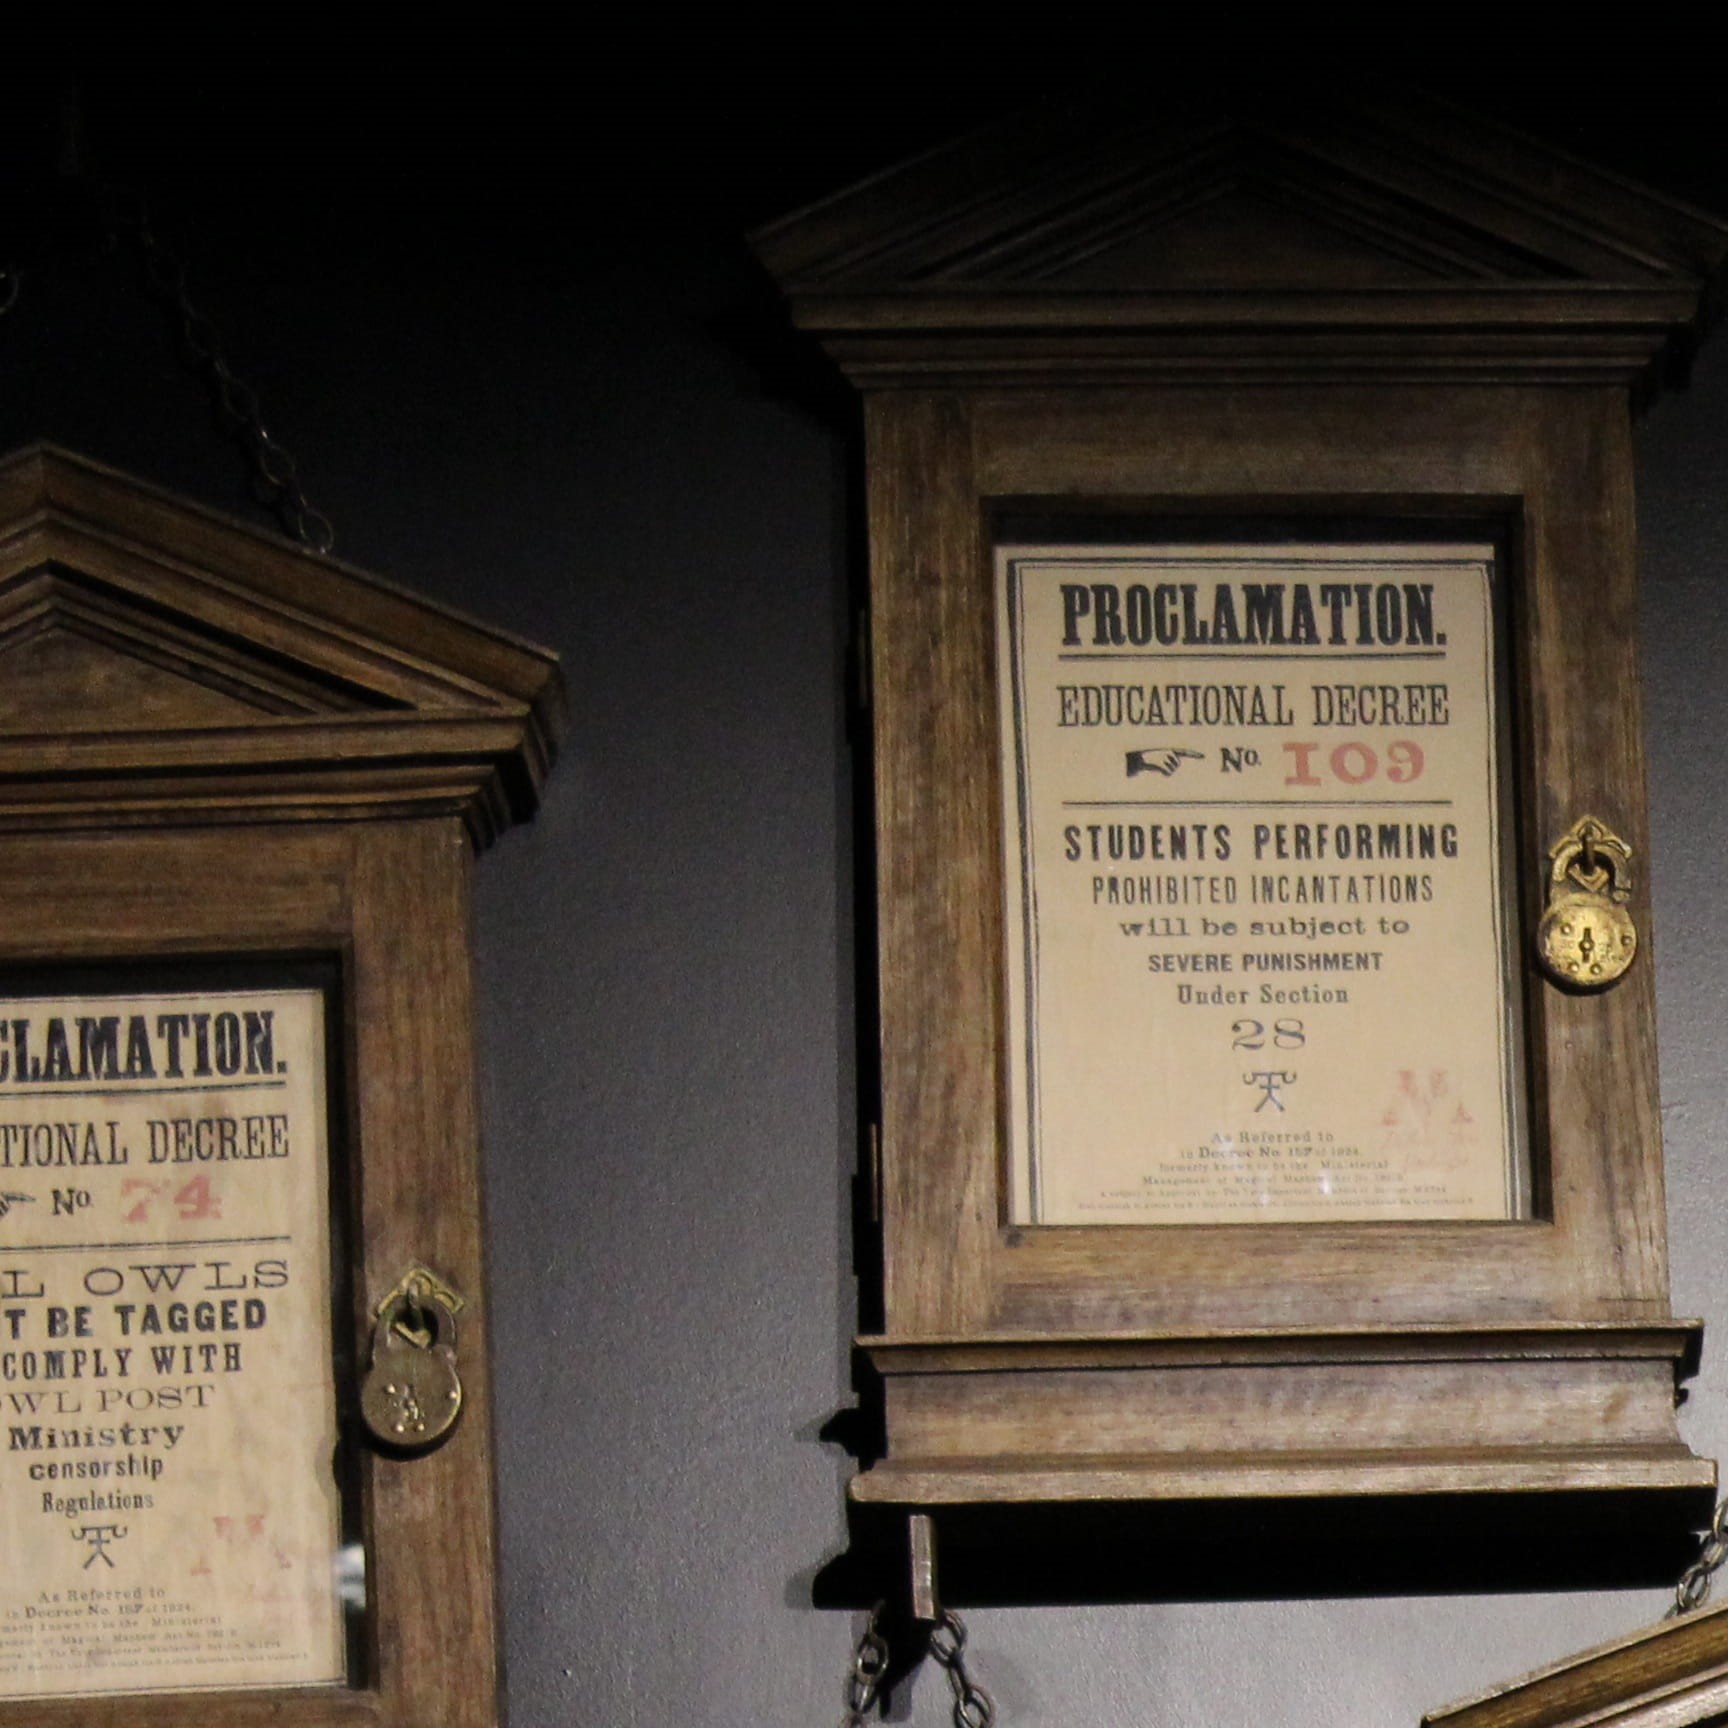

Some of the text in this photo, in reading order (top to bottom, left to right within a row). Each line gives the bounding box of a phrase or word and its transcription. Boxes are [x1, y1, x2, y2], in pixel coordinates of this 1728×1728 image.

[1060, 583, 1446, 647] PROCLAMATION.
[1057, 684, 1449, 727] EDUCATIONAL DECREE
[1064, 824, 1458, 862] STUDENTS PERFORMING
[1093, 874, 1433, 904] PROHIBITED INCANTATIONS
[1119, 918, 1410, 940] will be subject to
[1148, 952, 1383, 972] SEVERE PUNISHMENT
[1177, 985, 1349, 1005] Under Section
[1230, 1018, 1306, 1051] 28
[146, 1114, 289, 1164] DECREE
[119, 1174, 223, 1225] 74
[85, 1259, 290, 1296] OWLS
[48, 1304, 94, 1338] BE
[115, 1297, 267, 1334] TAGGED
[1, 1342, 242, 1380] COMPLY WITH
[97, 1383, 216, 1413] POST
[8, 1423, 184, 1450] Ministry
[29, 1455, 164, 1481] censorship
[42, 1490, 154, 1516] Regulations
